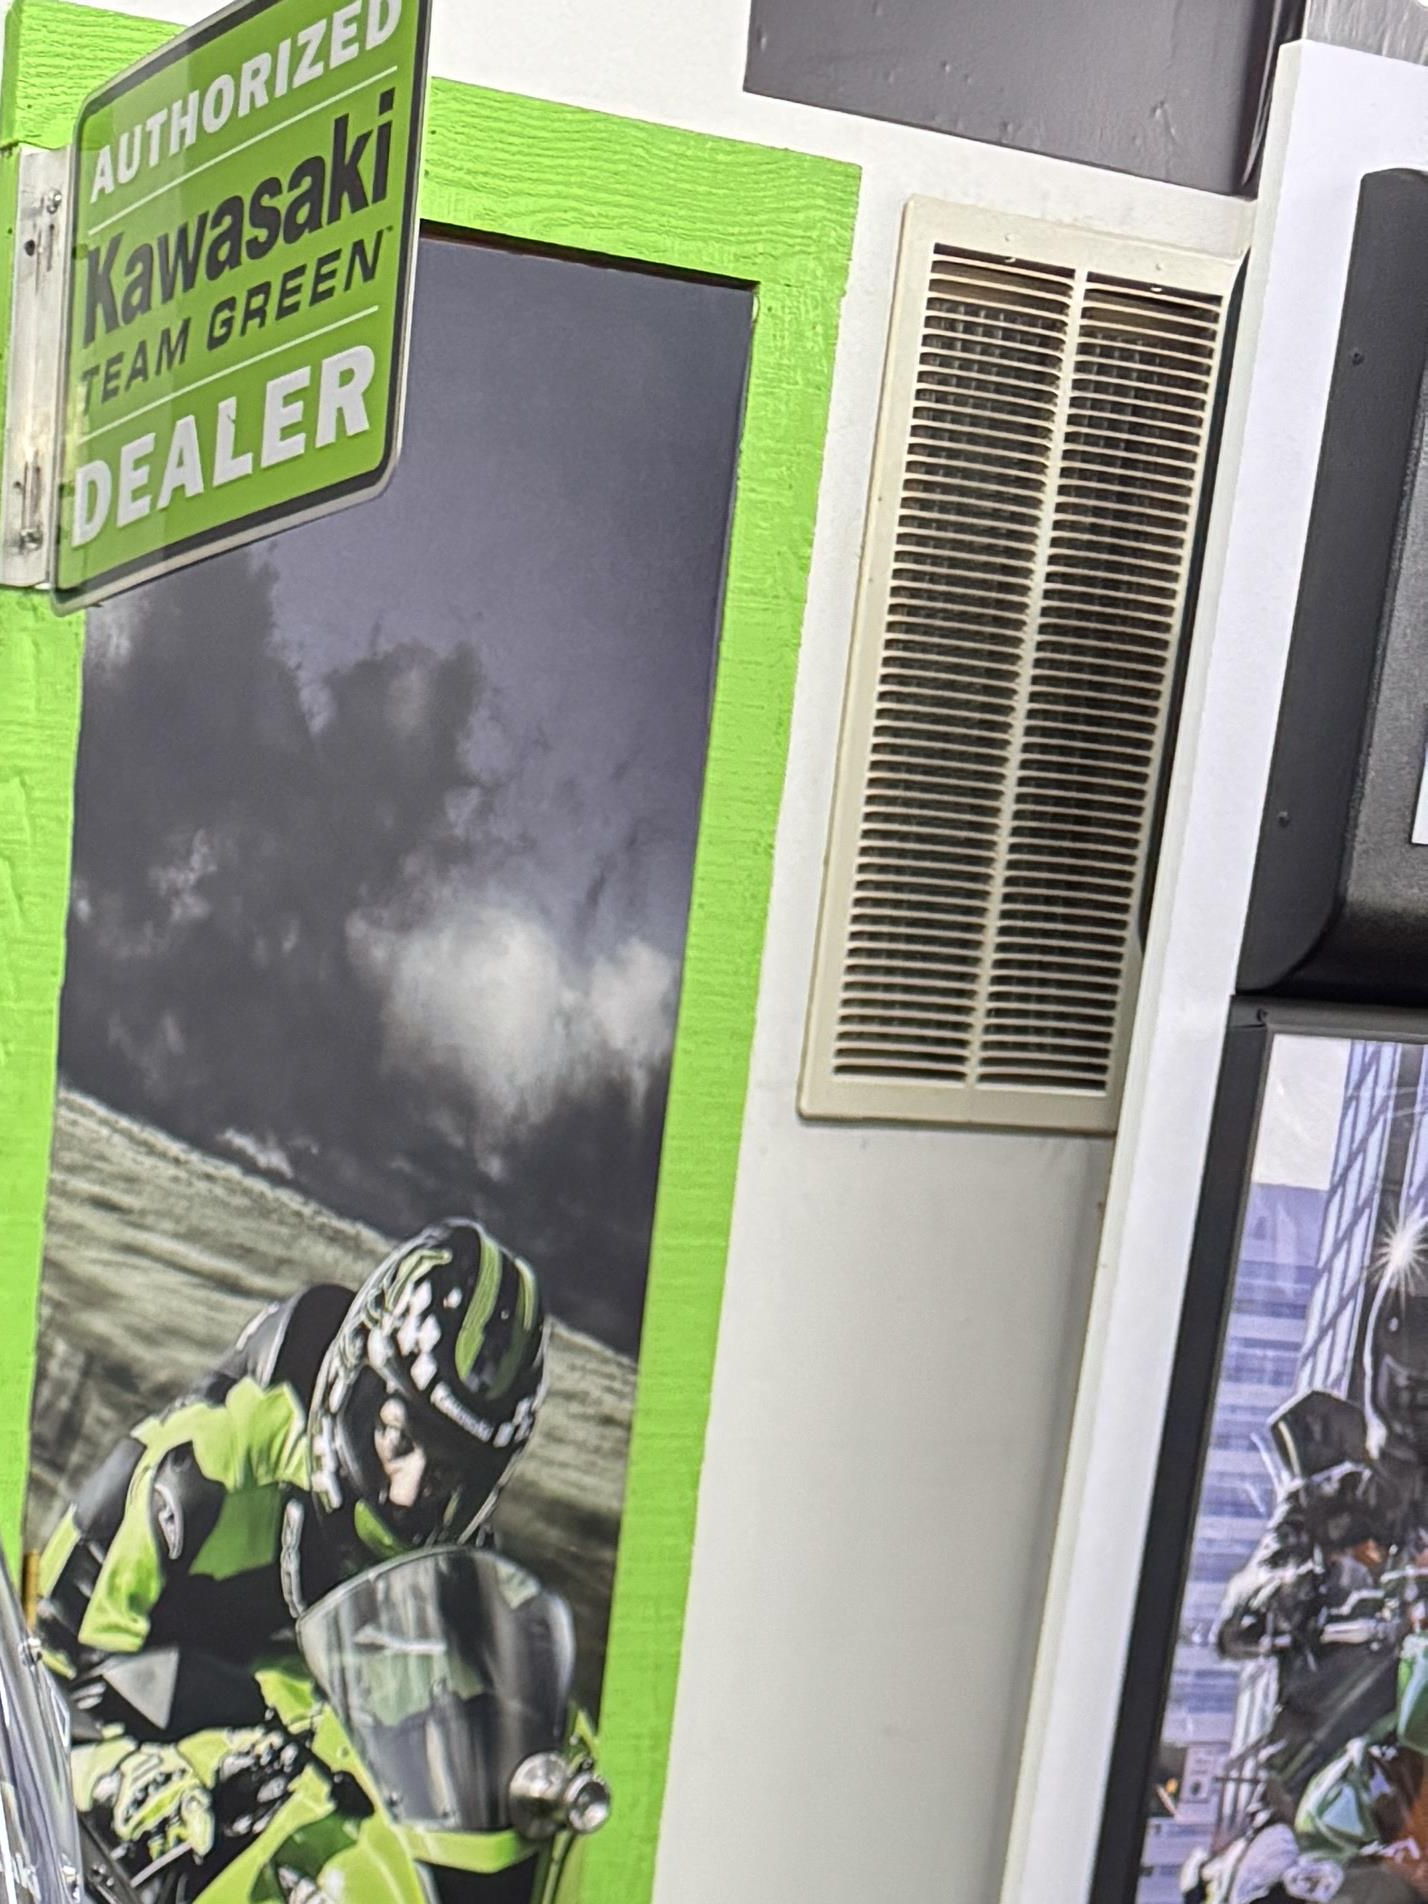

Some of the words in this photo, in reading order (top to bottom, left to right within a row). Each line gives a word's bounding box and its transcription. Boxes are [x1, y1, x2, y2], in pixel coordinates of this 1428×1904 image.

[90, 0, 402, 203] AUTHORIZED
[82, 87, 397, 349] Kawasaki
[80, 317, 192, 415] TEAM
[206, 229, 385, 353] GREEN
[71, 344, 377, 548] DEALER
